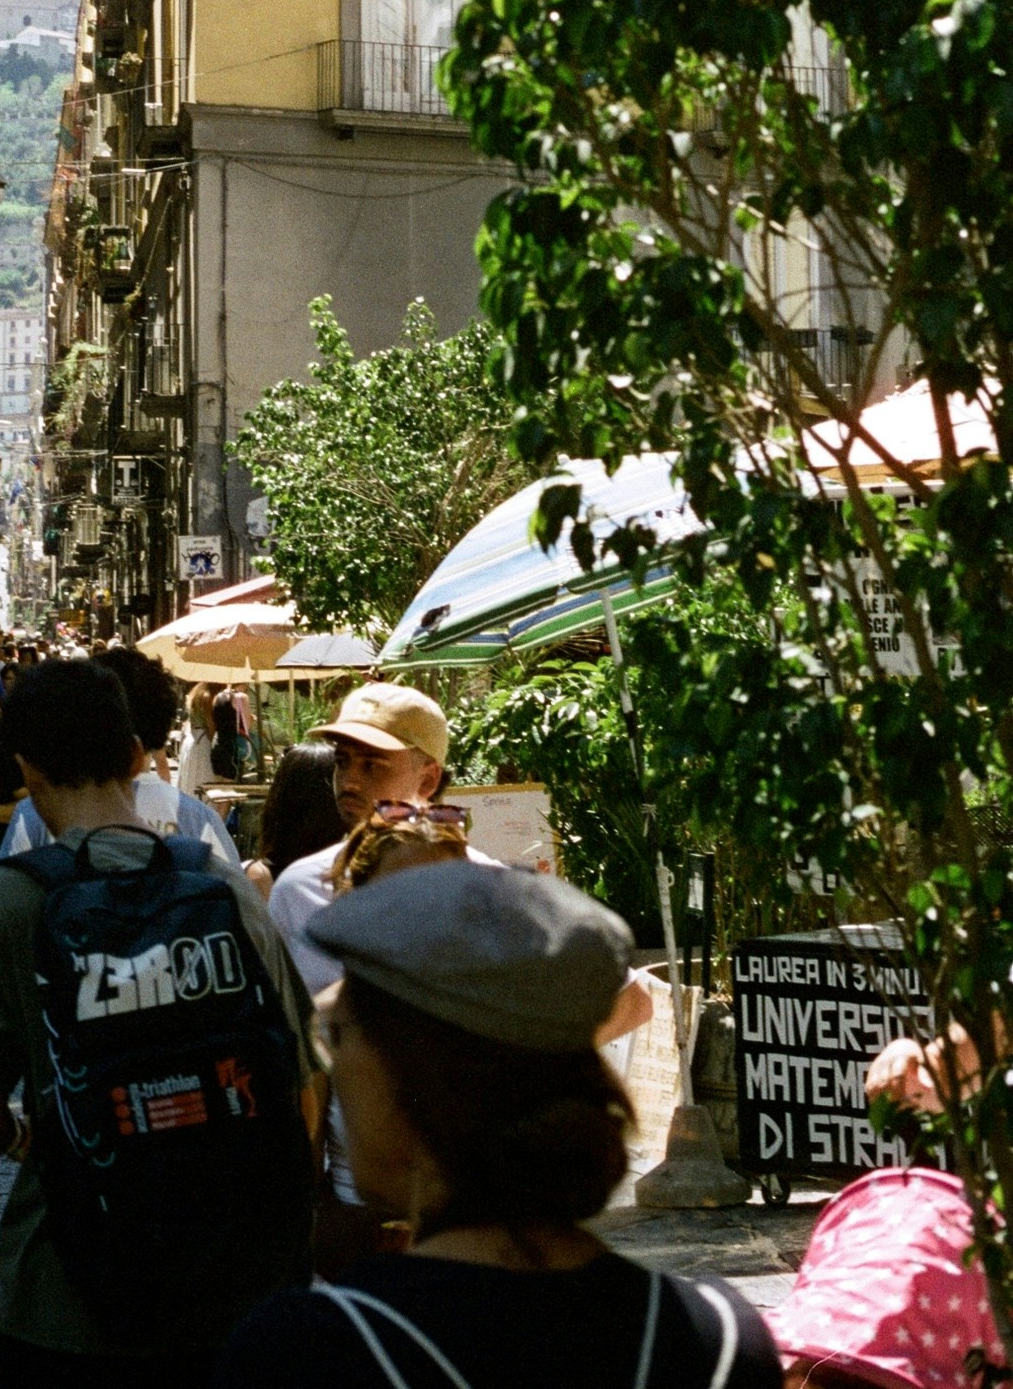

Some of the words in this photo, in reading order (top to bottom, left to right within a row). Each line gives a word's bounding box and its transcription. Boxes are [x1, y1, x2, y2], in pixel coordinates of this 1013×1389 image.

[735, 956, 820, 985] LAUREA
[826, 960, 847, 989] IN
[851, 963, 866, 992] 3
[869, 965, 929, 996] MINU
[759, 1112, 794, 1160] DI
